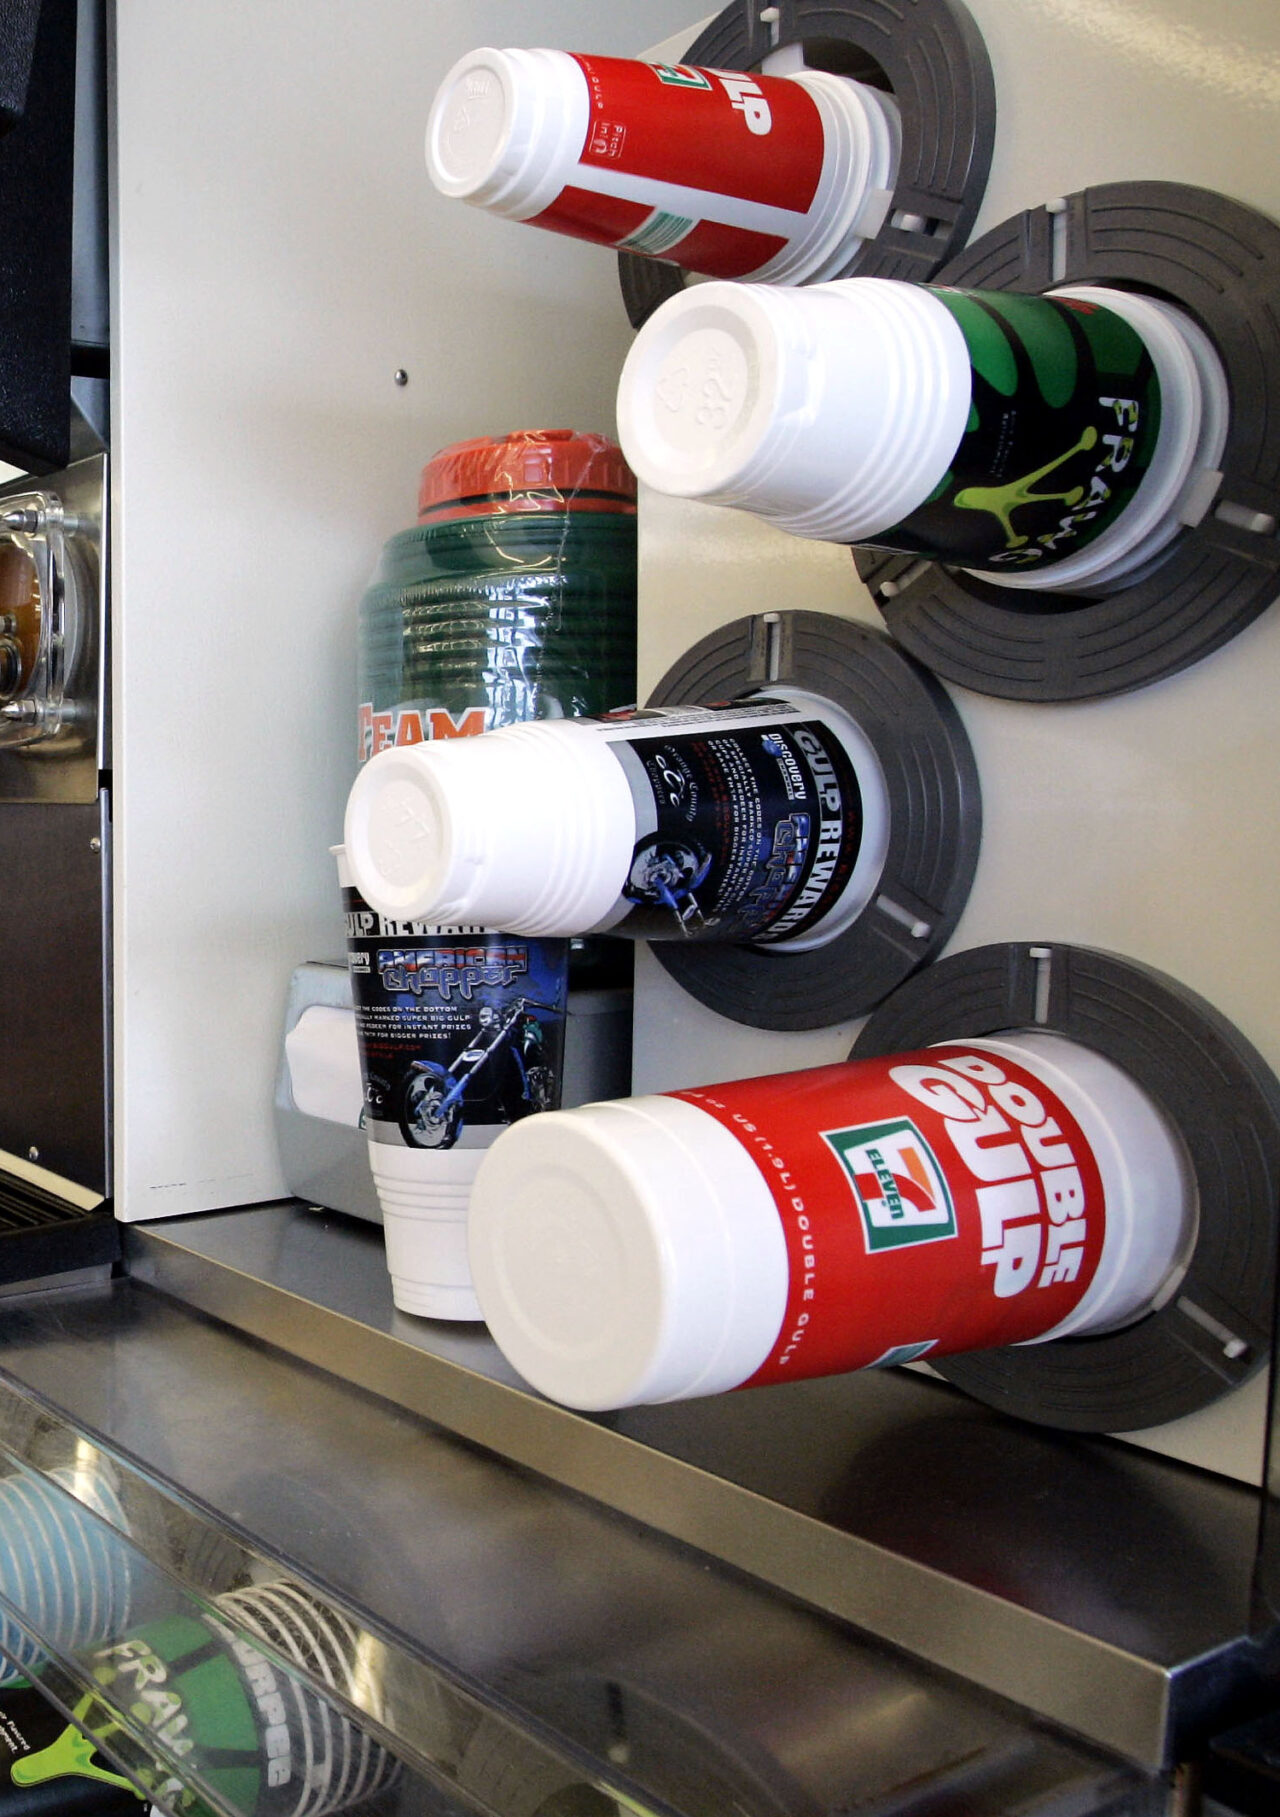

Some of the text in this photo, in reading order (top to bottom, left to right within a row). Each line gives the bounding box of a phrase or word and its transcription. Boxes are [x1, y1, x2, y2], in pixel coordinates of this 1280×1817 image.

[357, 702, 489, 762] TEAM
[794, 730, 841, 812] GULP
[888, 1064, 1042, 1298] GULP
[938, 1055, 1087, 1288] DOUBLE
[790, 1197, 815, 1301] DOUBLE
[778, 1312, 810, 1365] GULP
